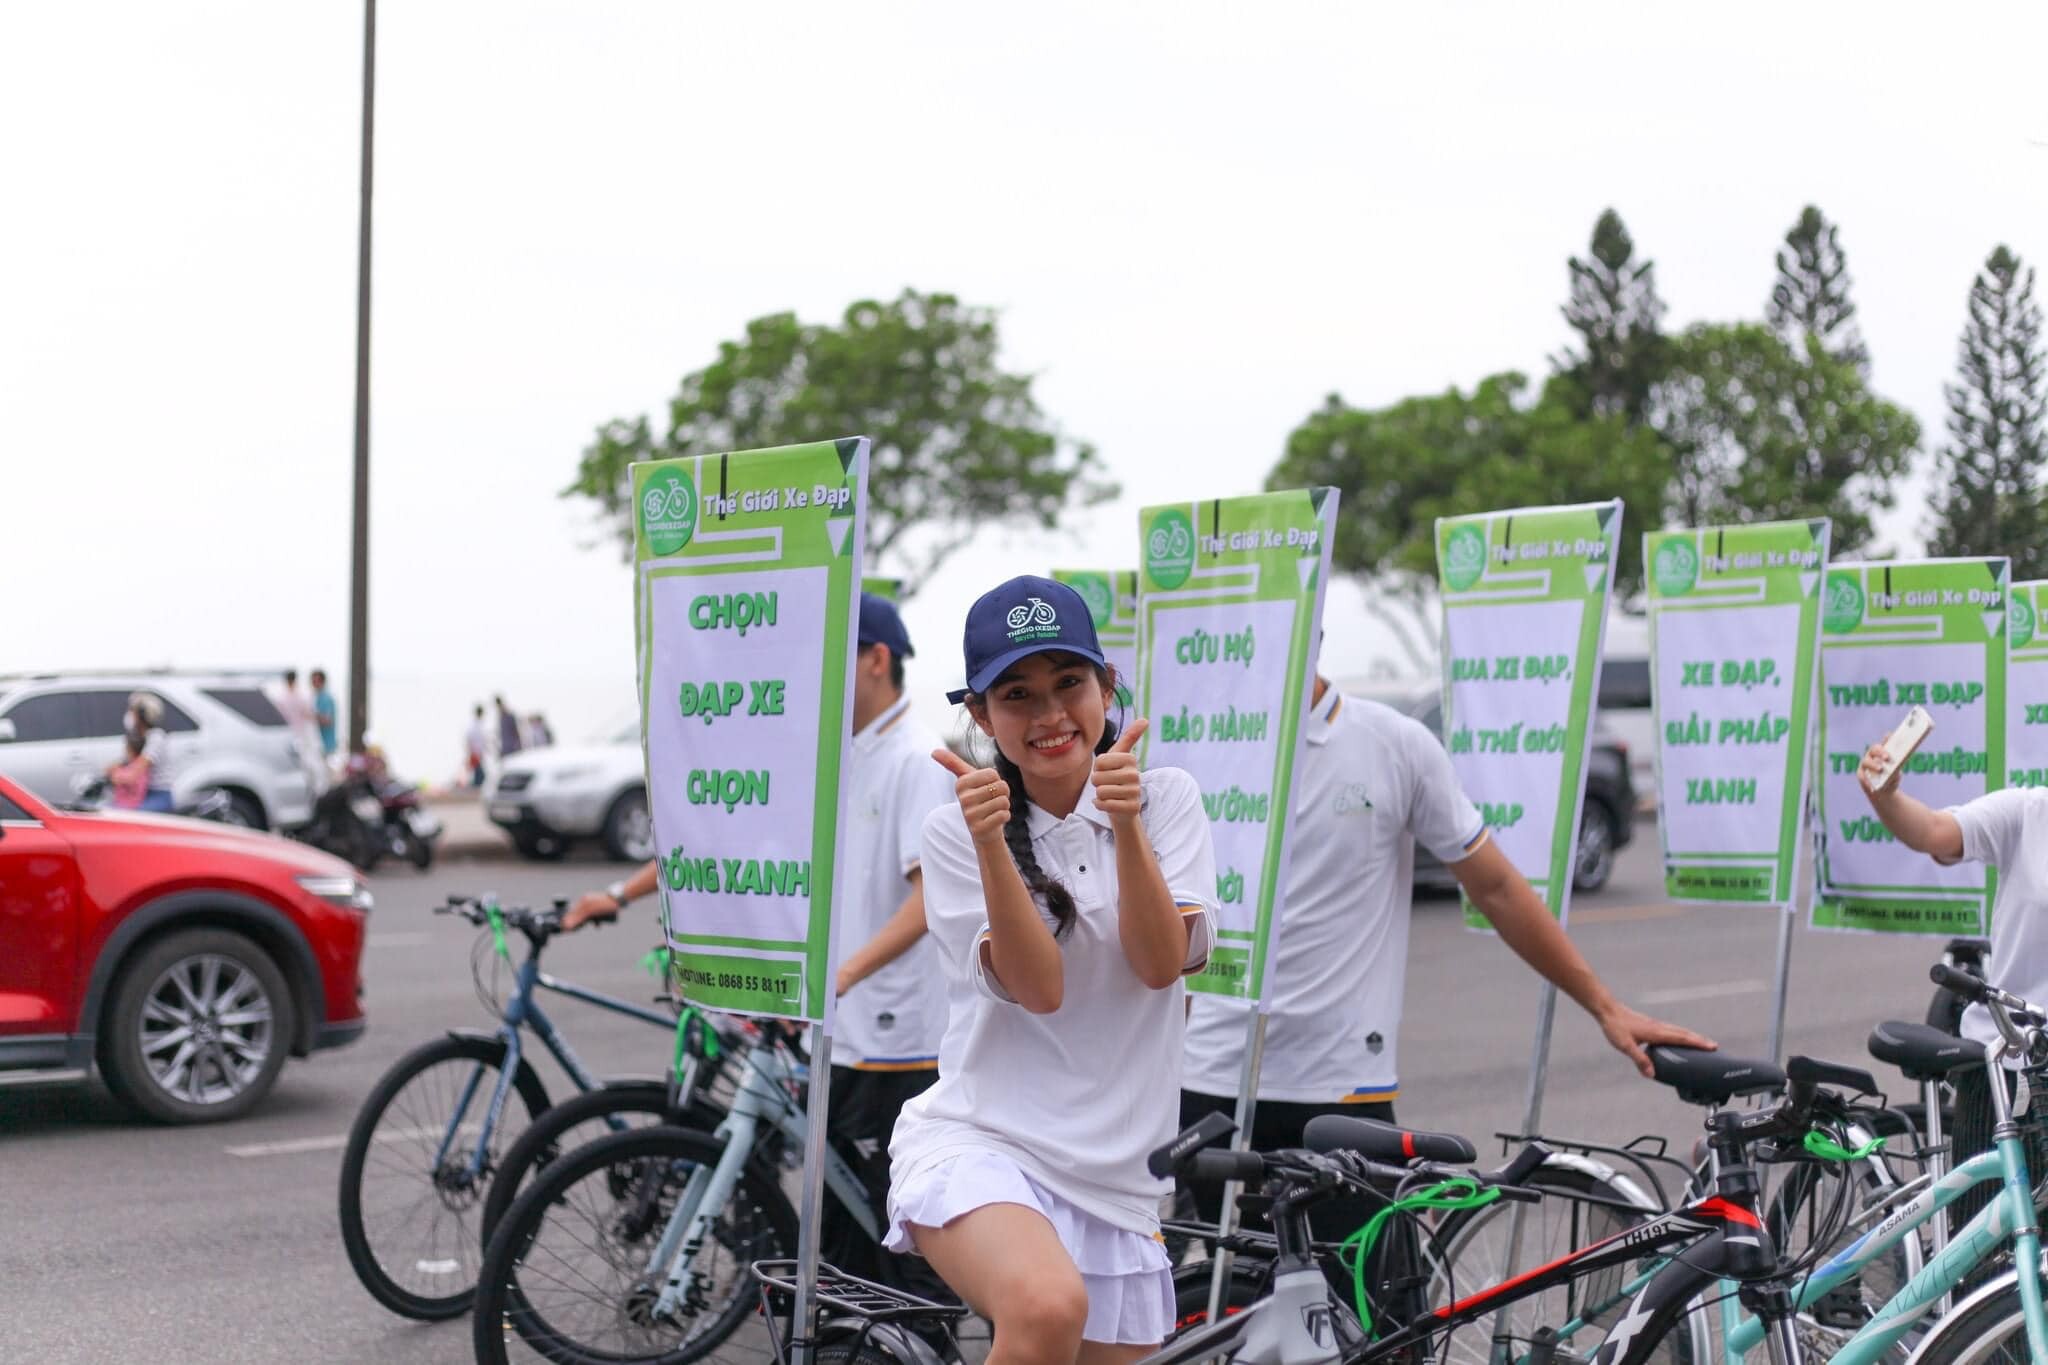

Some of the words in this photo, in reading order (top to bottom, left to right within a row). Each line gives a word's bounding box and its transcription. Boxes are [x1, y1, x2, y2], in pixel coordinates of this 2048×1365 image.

[704, 490, 739, 516] Thế
[743, 488, 779, 513] Giới
[784, 487, 808, 509] Xe
[813, 484, 850, 509] Đạp
[1264, 528, 1282, 548] Xe
[688, 591, 778, 636] CHỌN
[1175, 627, 1219, 665] CỨU
[1223, 624, 1255, 669] HỘ
[1492, 655, 1520, 681] XE
[1680, 661, 1715, 687] XE
[680, 681, 744, 725] ĐẠP
[747, 680, 786, 716] XE
[1829, 678, 1891, 706] THUÊ
[1895, 682, 1927, 704] XE
[1931, 681, 1984, 709] ĐẠP
[1160, 703, 1204, 742] BẢO
[1208, 703, 1268, 742] HÀNH
[1477, 721, 1523, 752] THẾ
[1665, 710, 1711, 745] GIẢI
[1718, 710, 1789, 744] PHÁP
[687, 769, 770, 813] CHỌN
[1686, 777, 1758, 805] XANH
[721, 859, 810, 898] XANH
[719, 973, 743, 990] 0868
[745, 975, 759, 991] 55
[761, 976, 773, 993] 88
[775, 978, 788, 994] 11
[1879, 1201, 1921, 1238] ASAMA
